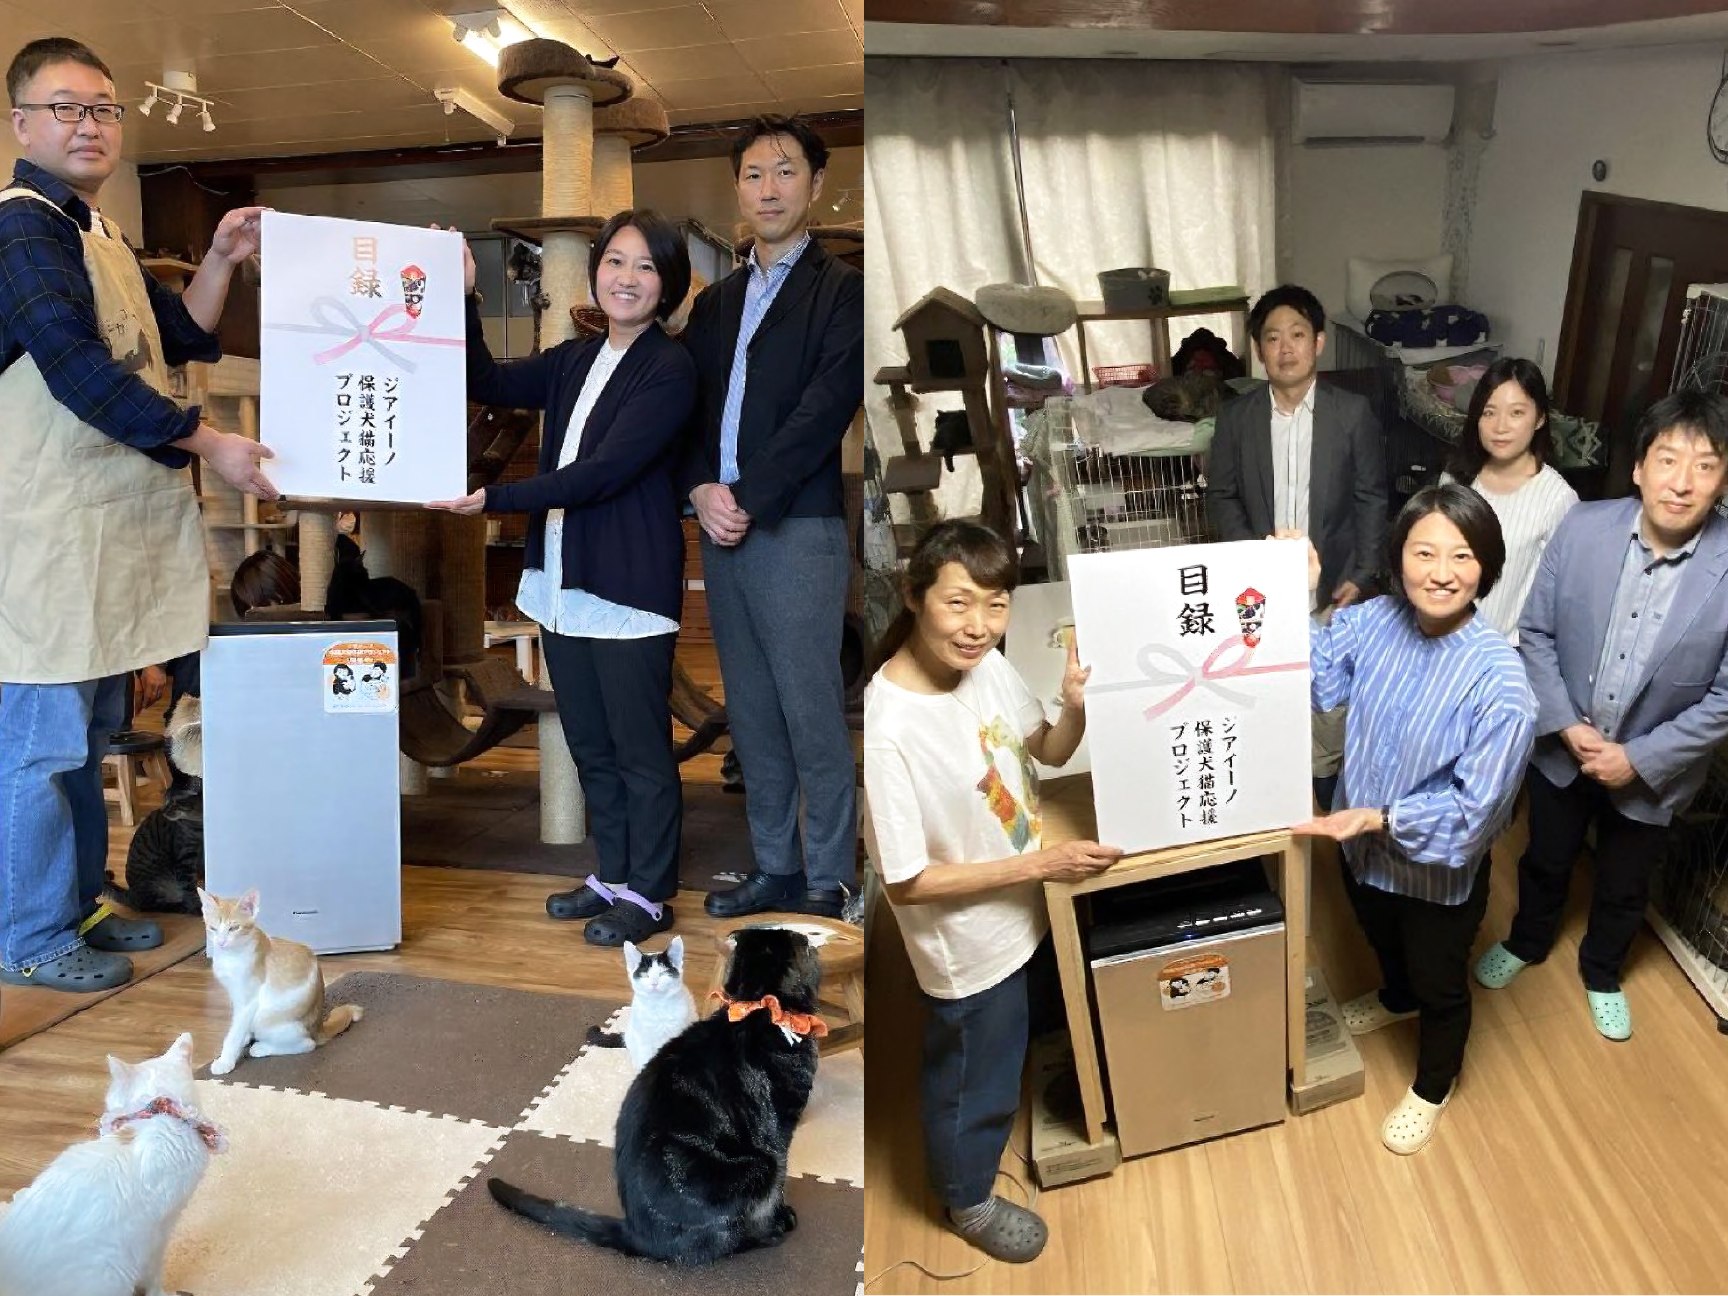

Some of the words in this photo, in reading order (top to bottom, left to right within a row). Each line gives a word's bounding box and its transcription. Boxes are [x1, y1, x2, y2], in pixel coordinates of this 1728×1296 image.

[335, 373, 353, 482] プロジェクト
[358, 374, 376, 485] 保護犬猫応援
[383, 376, 399, 466] ジアイーノ
[1178, 564, 1215, 637] 目録
[1170, 722, 1192, 829] プロジェクト
[1194, 720, 1218, 825] 保護犬猫応援
[1222, 716, 1238, 805] ジアイーノ
